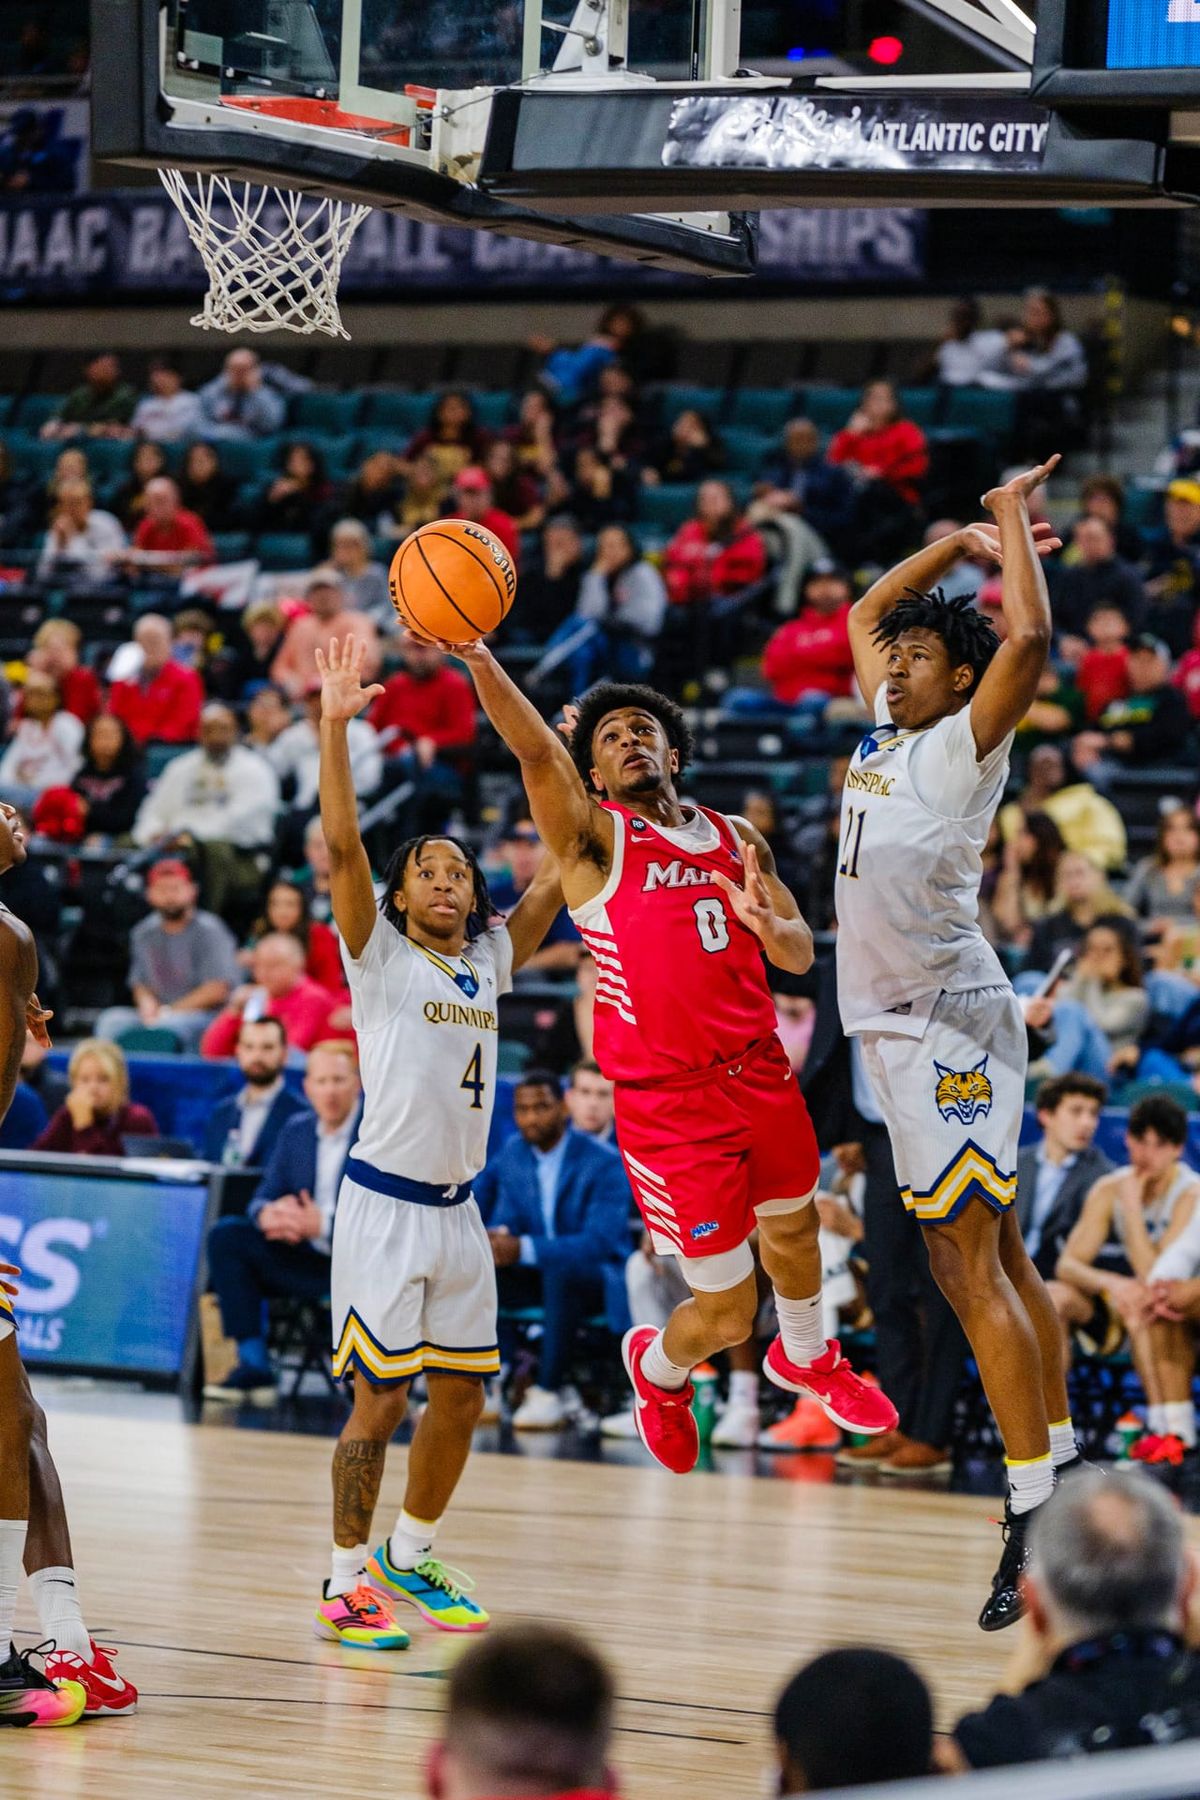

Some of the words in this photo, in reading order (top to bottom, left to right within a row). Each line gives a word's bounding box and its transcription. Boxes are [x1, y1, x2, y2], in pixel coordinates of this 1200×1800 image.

[869, 122, 986, 152] ATLANTIC
[989, 122, 1049, 152] CITY
[0, 207, 107, 279] AAC
[839, 805, 867, 879] 21
[692, 898, 730, 954] 0
[460, 1042, 485, 1109] 4
